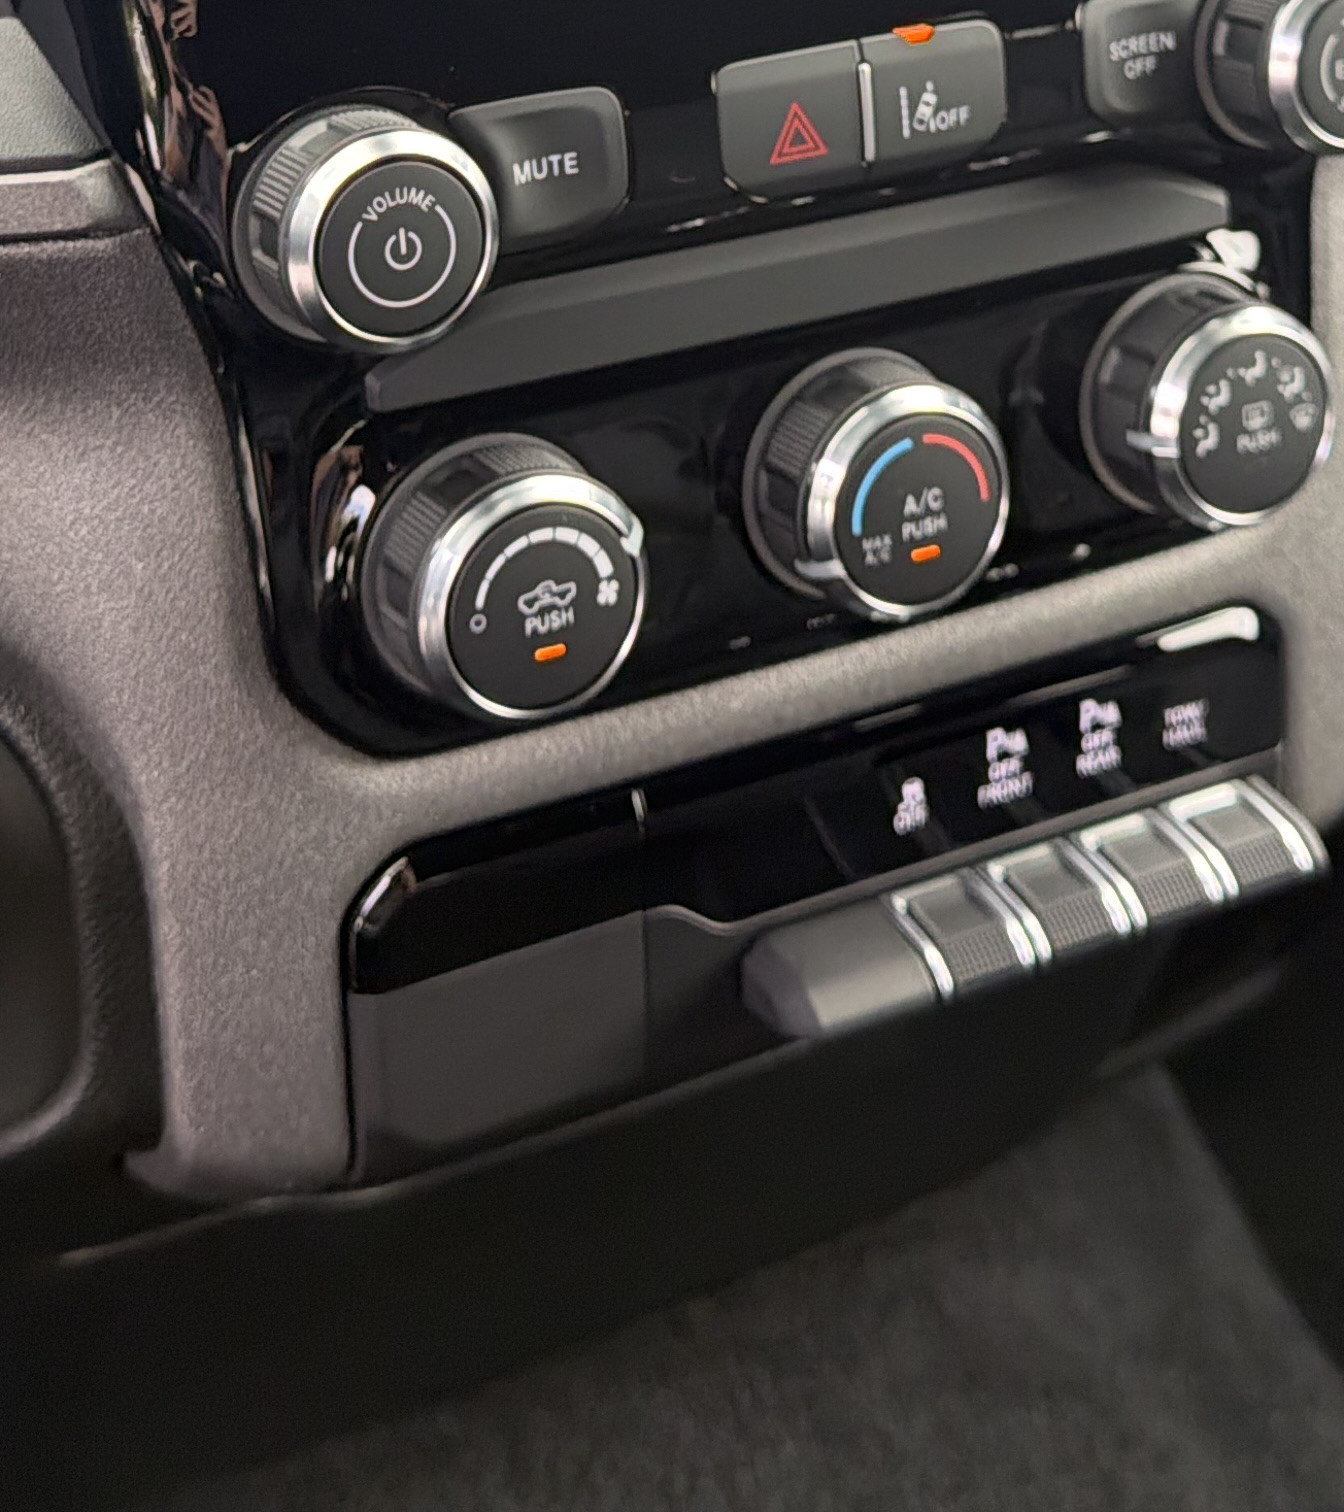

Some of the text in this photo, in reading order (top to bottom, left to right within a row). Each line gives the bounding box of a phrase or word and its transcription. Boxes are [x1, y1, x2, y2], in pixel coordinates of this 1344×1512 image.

[1108, 30, 1177, 61] SCREEN
[936, 104, 972, 132] OFF
[512, 151, 579, 187] MUTE
[361, 186, 436, 223] VOLUME
[524, 606, 575, 637] PUSH
